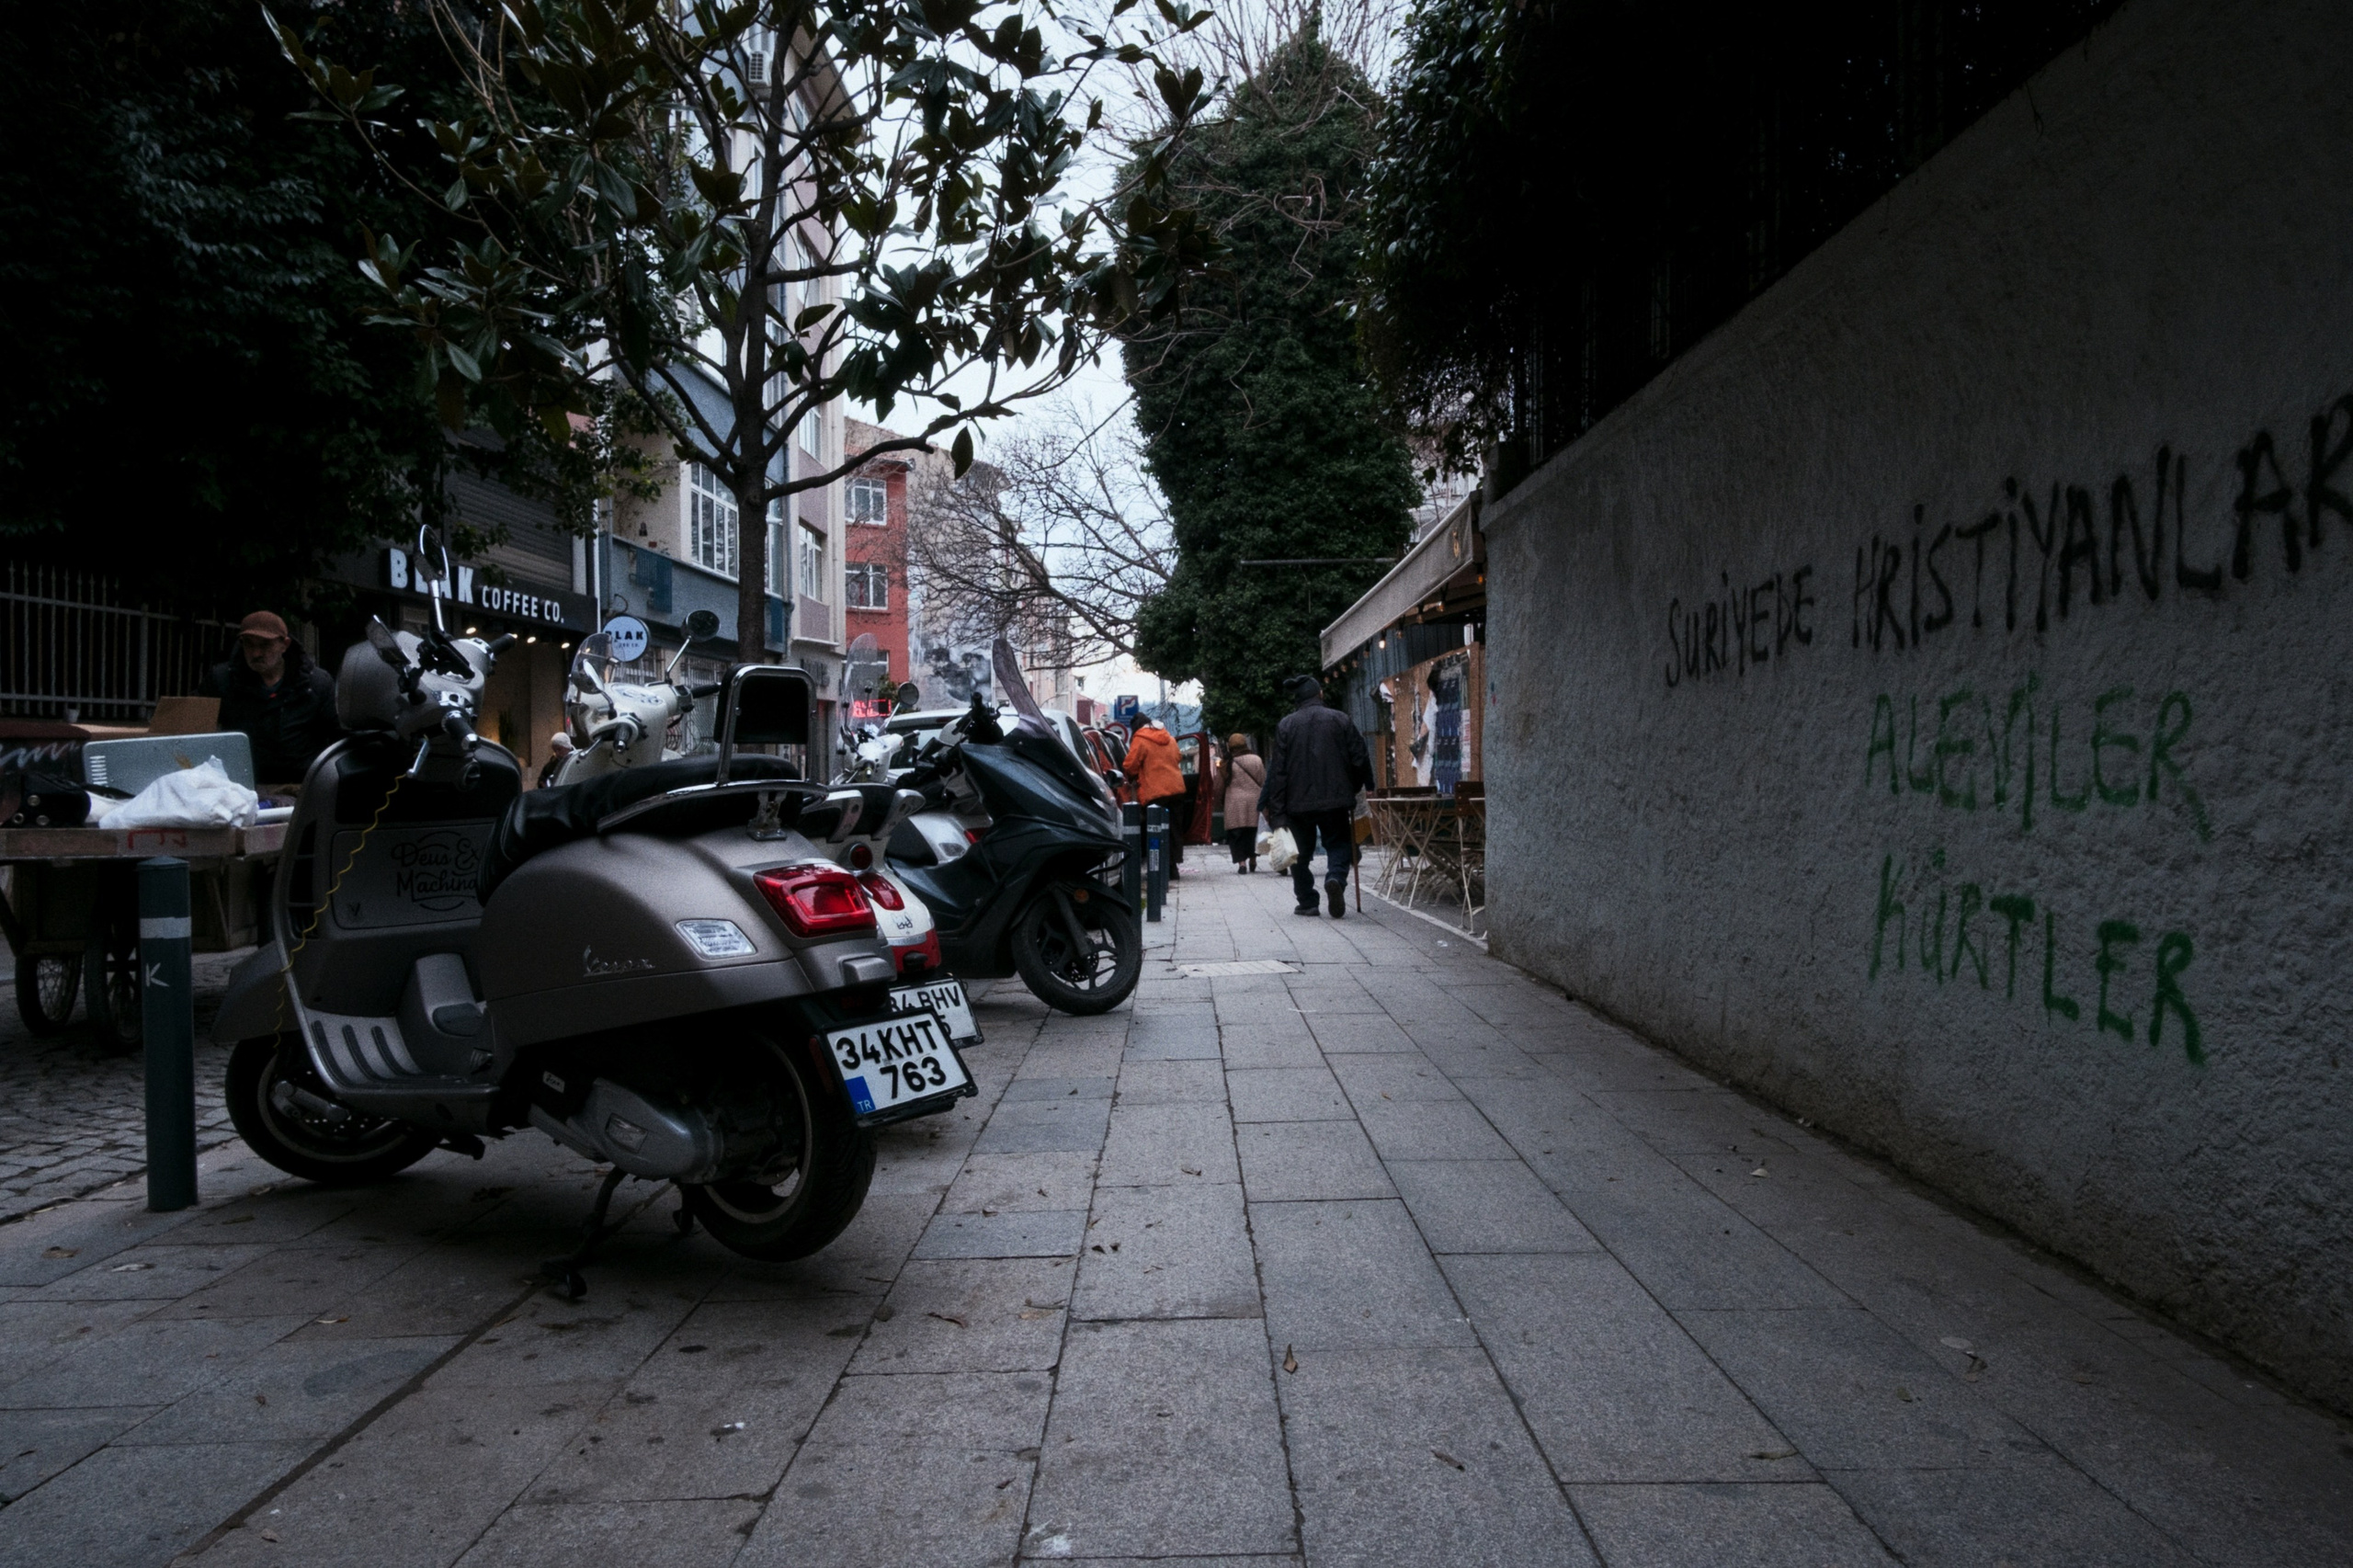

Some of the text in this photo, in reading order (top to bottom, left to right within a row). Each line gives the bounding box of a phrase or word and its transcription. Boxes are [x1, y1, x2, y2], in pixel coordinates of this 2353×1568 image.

[482, 585, 539, 618] COFFEE
[544, 599, 564, 624] CO.
[391, 837, 479, 870] Deus Ex
[396, 869, 478, 902] Machina
[880, 1056, 946, 1099] 763
[858, 1099, 872, 1111] TR
